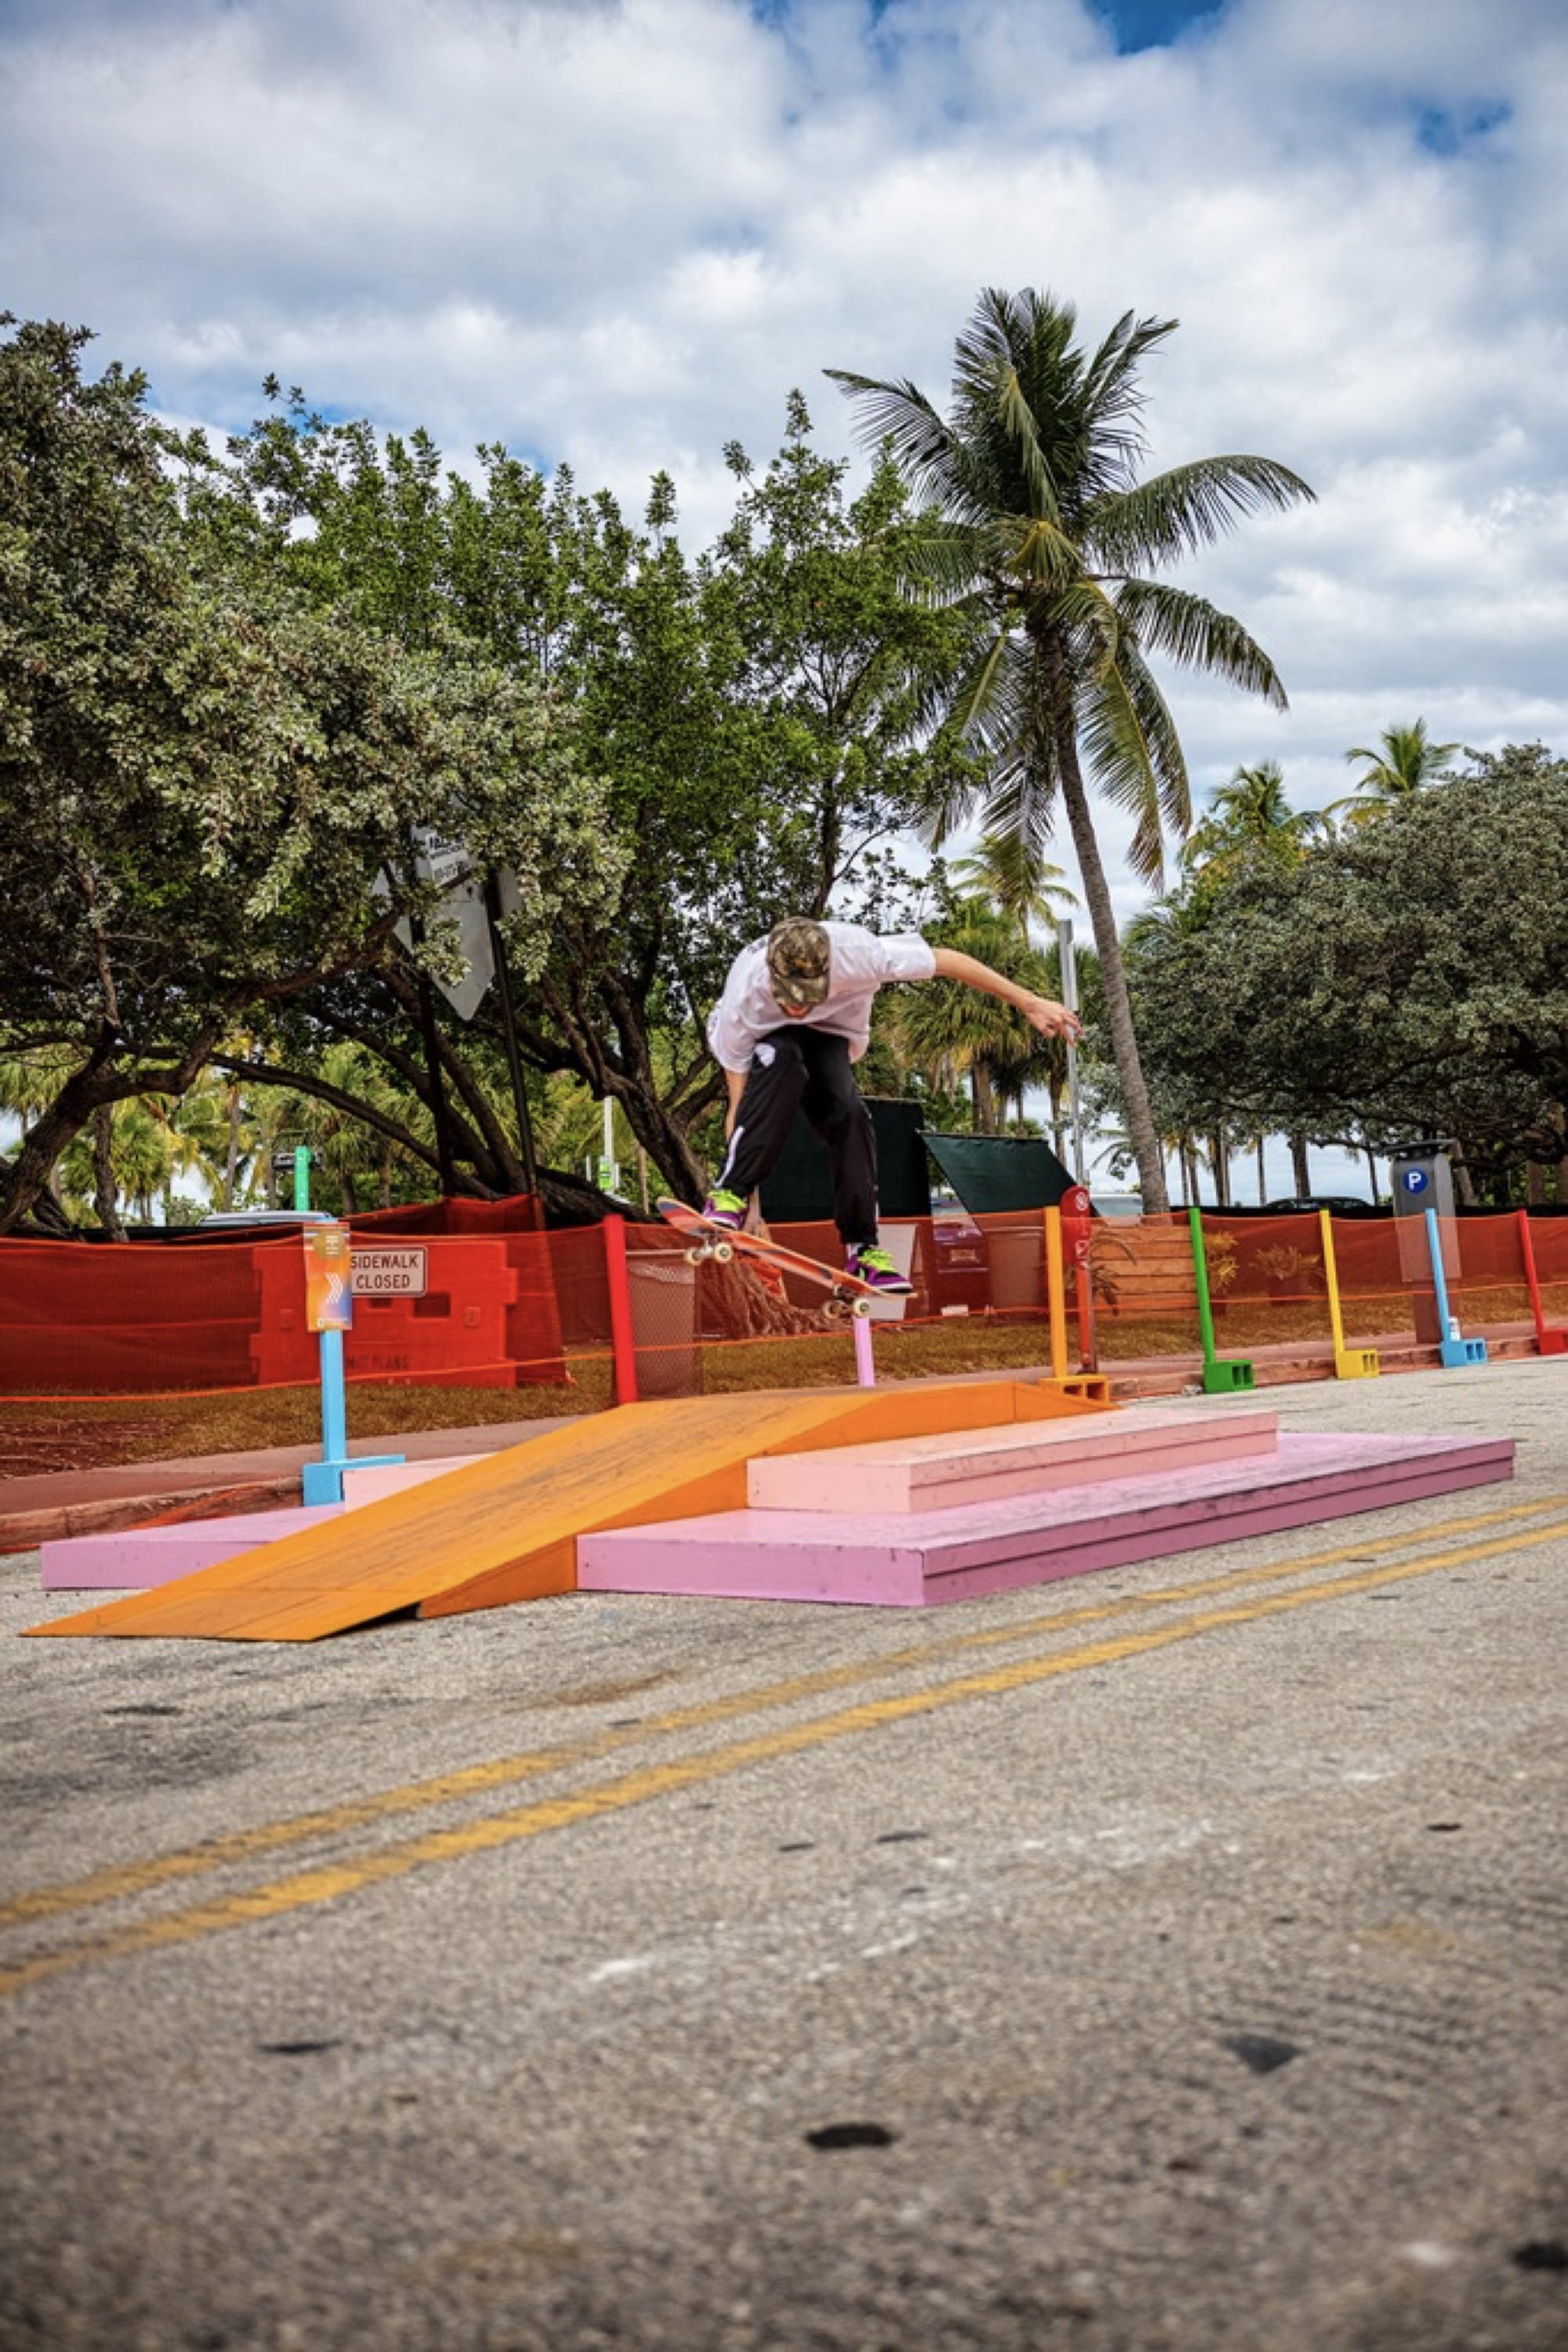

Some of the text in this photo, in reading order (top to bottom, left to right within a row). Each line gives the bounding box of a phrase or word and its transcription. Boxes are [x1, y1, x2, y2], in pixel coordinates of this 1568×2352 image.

[1409, 1172, 1421, 1190] P
[350, 1254, 419, 1269] SIDEWALK
[356, 1274, 410, 1289] CLOSED
